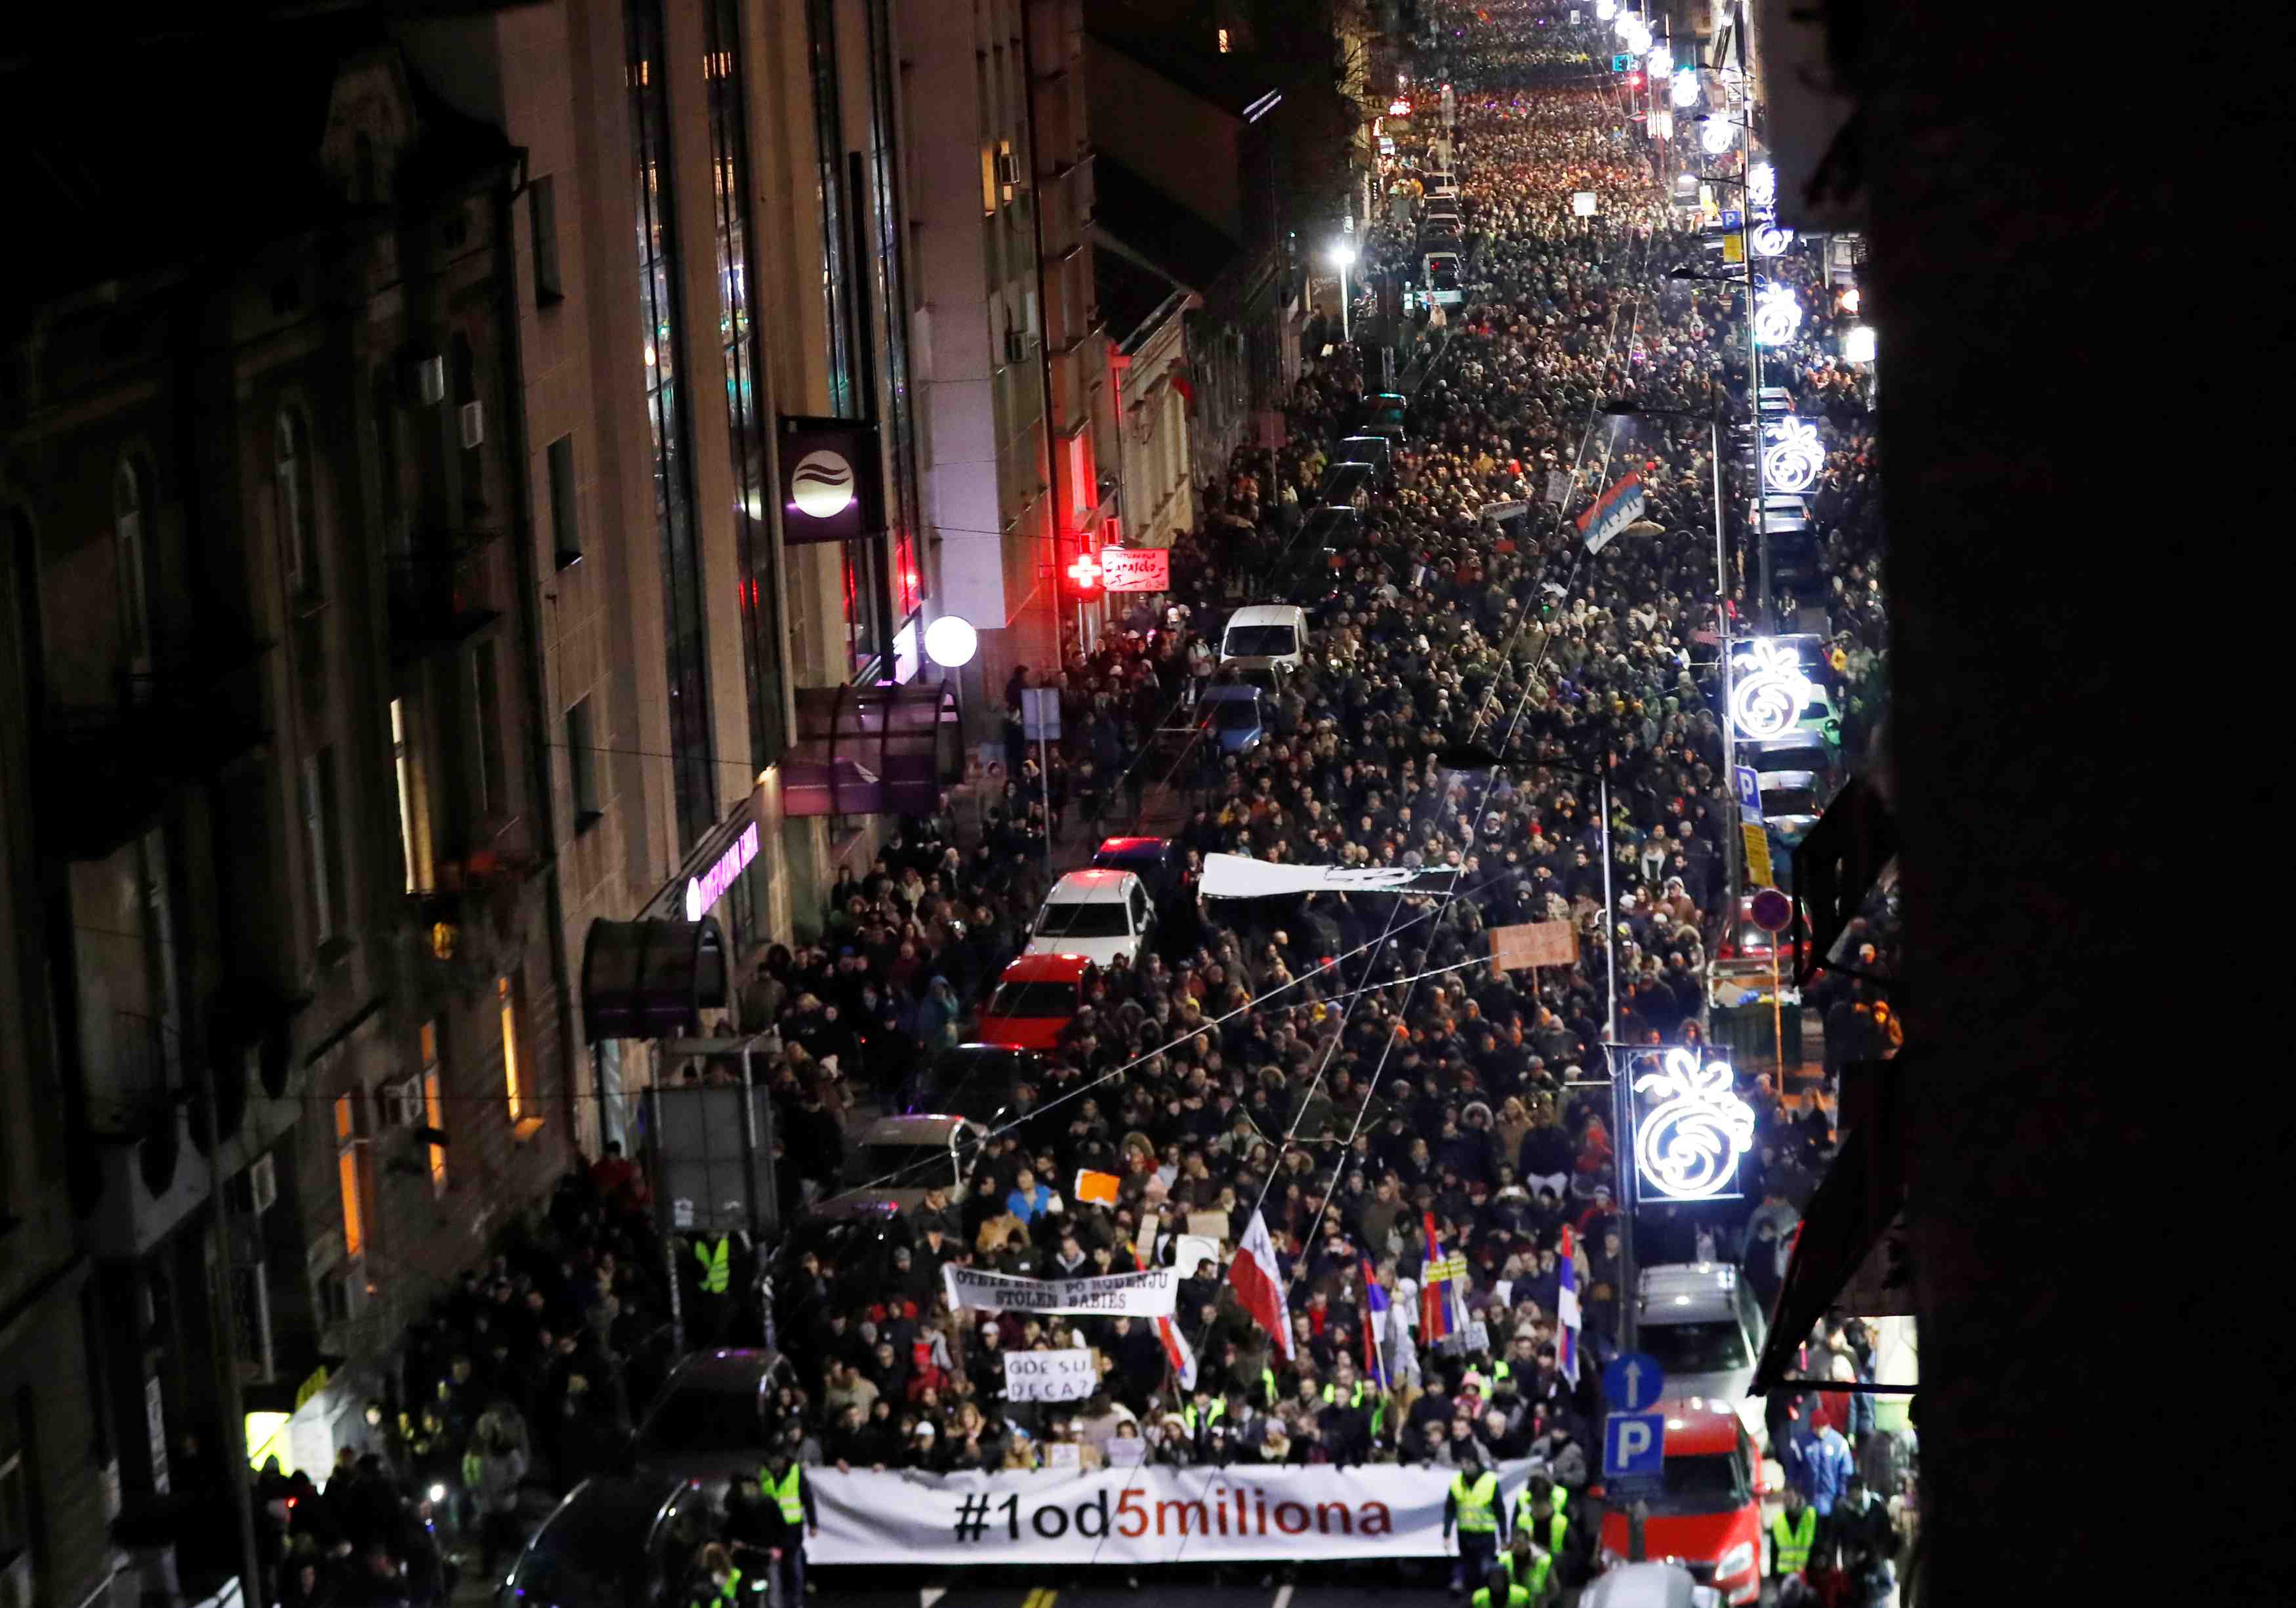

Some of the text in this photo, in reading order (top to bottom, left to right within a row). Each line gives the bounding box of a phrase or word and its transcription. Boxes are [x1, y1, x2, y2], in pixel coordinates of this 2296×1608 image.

[1740, 772, 1754, 802] P
[996, 1290, 1126, 1309] STOLEN BABIES
[1010, 1359, 1086, 1375] GDE SU
[1618, 1421, 1652, 1469] P
[953, 1487, 1393, 1542] #1od5miliona
